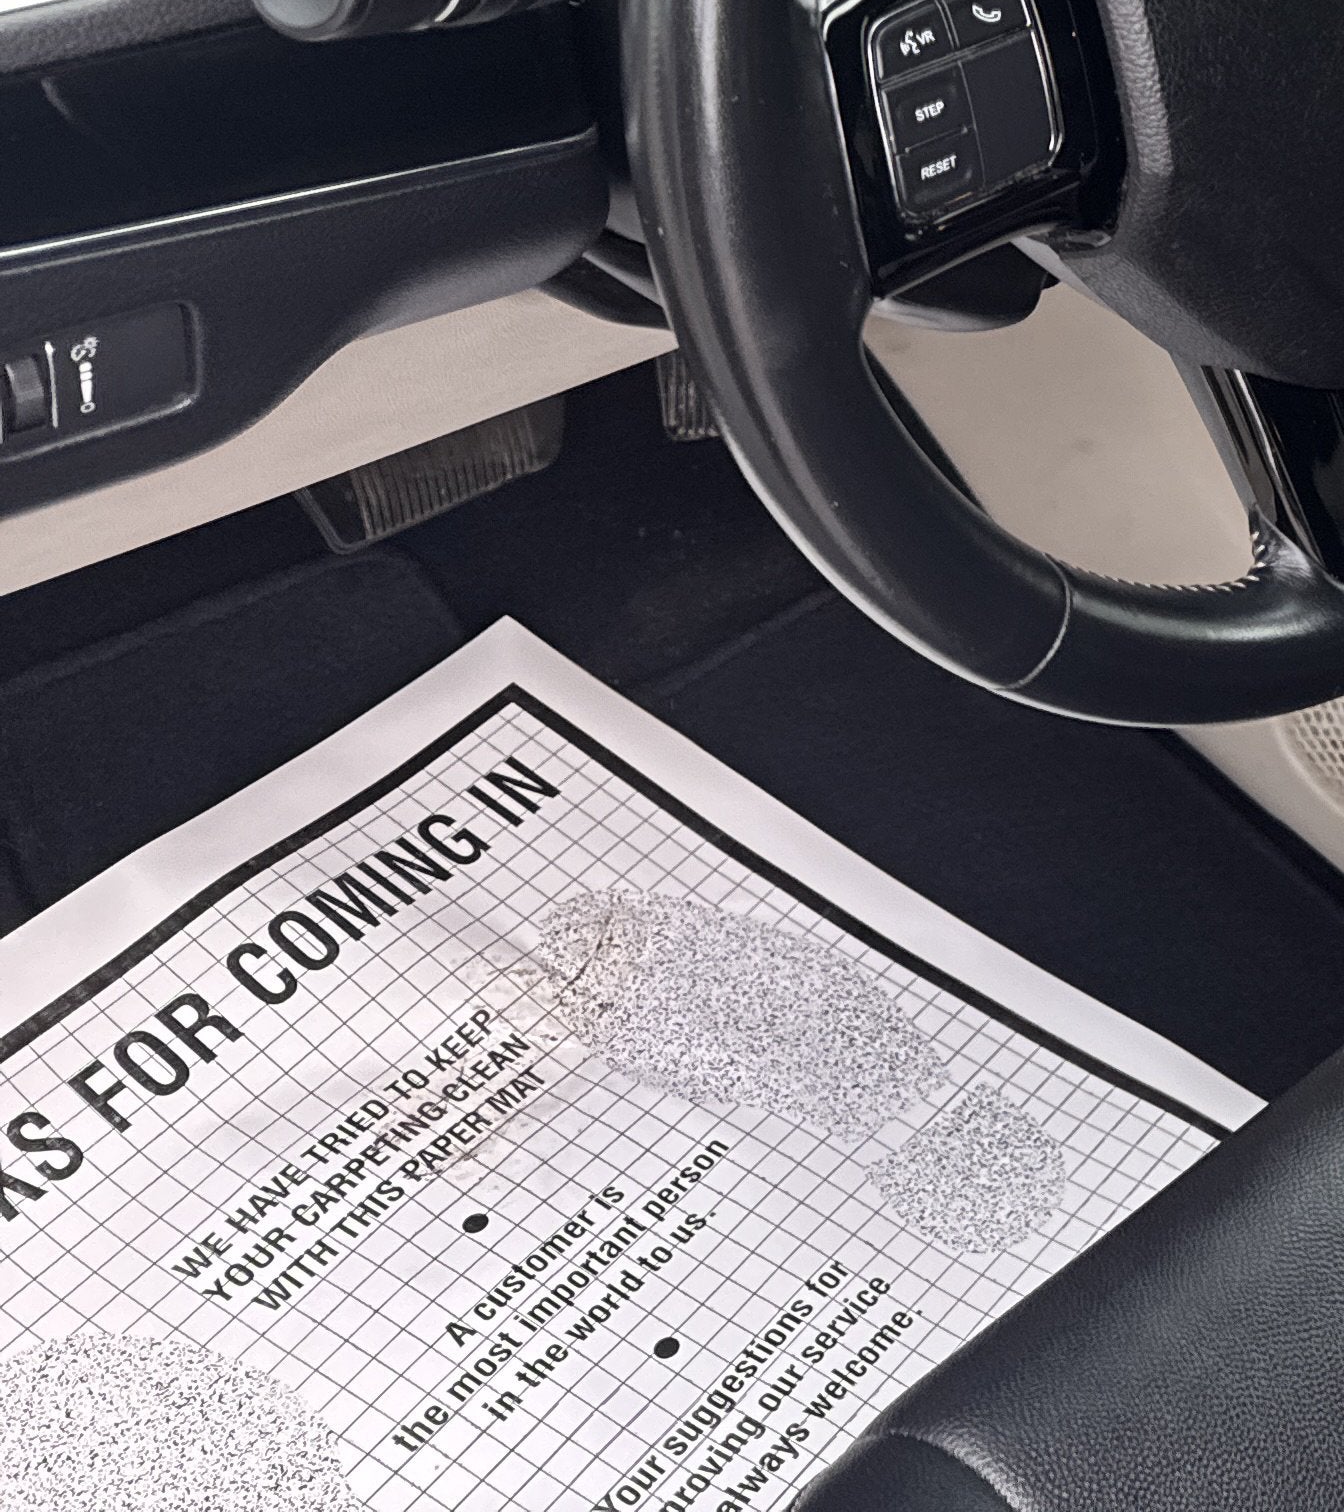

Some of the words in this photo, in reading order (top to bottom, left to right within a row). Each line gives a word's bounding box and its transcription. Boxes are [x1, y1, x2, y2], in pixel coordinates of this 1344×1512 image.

[915, 29, 936, 46] VR
[915, 99, 945, 122] STEP
[920, 154, 957, 181] RESET
[68, 993, 245, 1133] FOR
[226, 813, 491, 1005] COMING
[467, 756, 561, 827] IN
[172, 1231, 233, 1280] WE
[225, 1162, 311, 1235] HAVE
[300, 1098, 390, 1165] TRIED
[383, 1068, 430, 1101] TO
[424, 1009, 492, 1074] KEEP
[201, 1226, 298, 1302] YOUR
[290, 1099, 448, 1227] CARPETING
[441, 1032, 531, 1104] CLEAN
[252, 1238, 340, 1311] WITH
[332, 1178, 405, 1239] THIS
[400, 1110, 492, 1182] PAPER
[485, 1065, 545, 1115] MAT
[392, 1403, 449, 1452] the
[446, 1331, 524, 1403] most
[513, 1215, 647, 1332] important
[641, 1137, 729, 1222] person
[445, 1321, 477, 1348] A
[473, 1208, 596, 1321] customer
[588, 1186, 625, 1211] is
[481, 1390, 524, 1422] in
[516, 1343, 569, 1388] the
[565, 1269, 645, 1341] world
[636, 1244, 674, 1273] to
[669, 1211, 717, 1245] us.
[758, 1364, 804, 1412] our
[801, 1275, 892, 1364] service
[591, 1454, 667, 1512] Your
[663, 1298, 814, 1456] suggestions
[804, 1260, 849, 1298] for
[715, 1421, 811, 1512] always
[804, 1309, 922, 1420] welcome.
